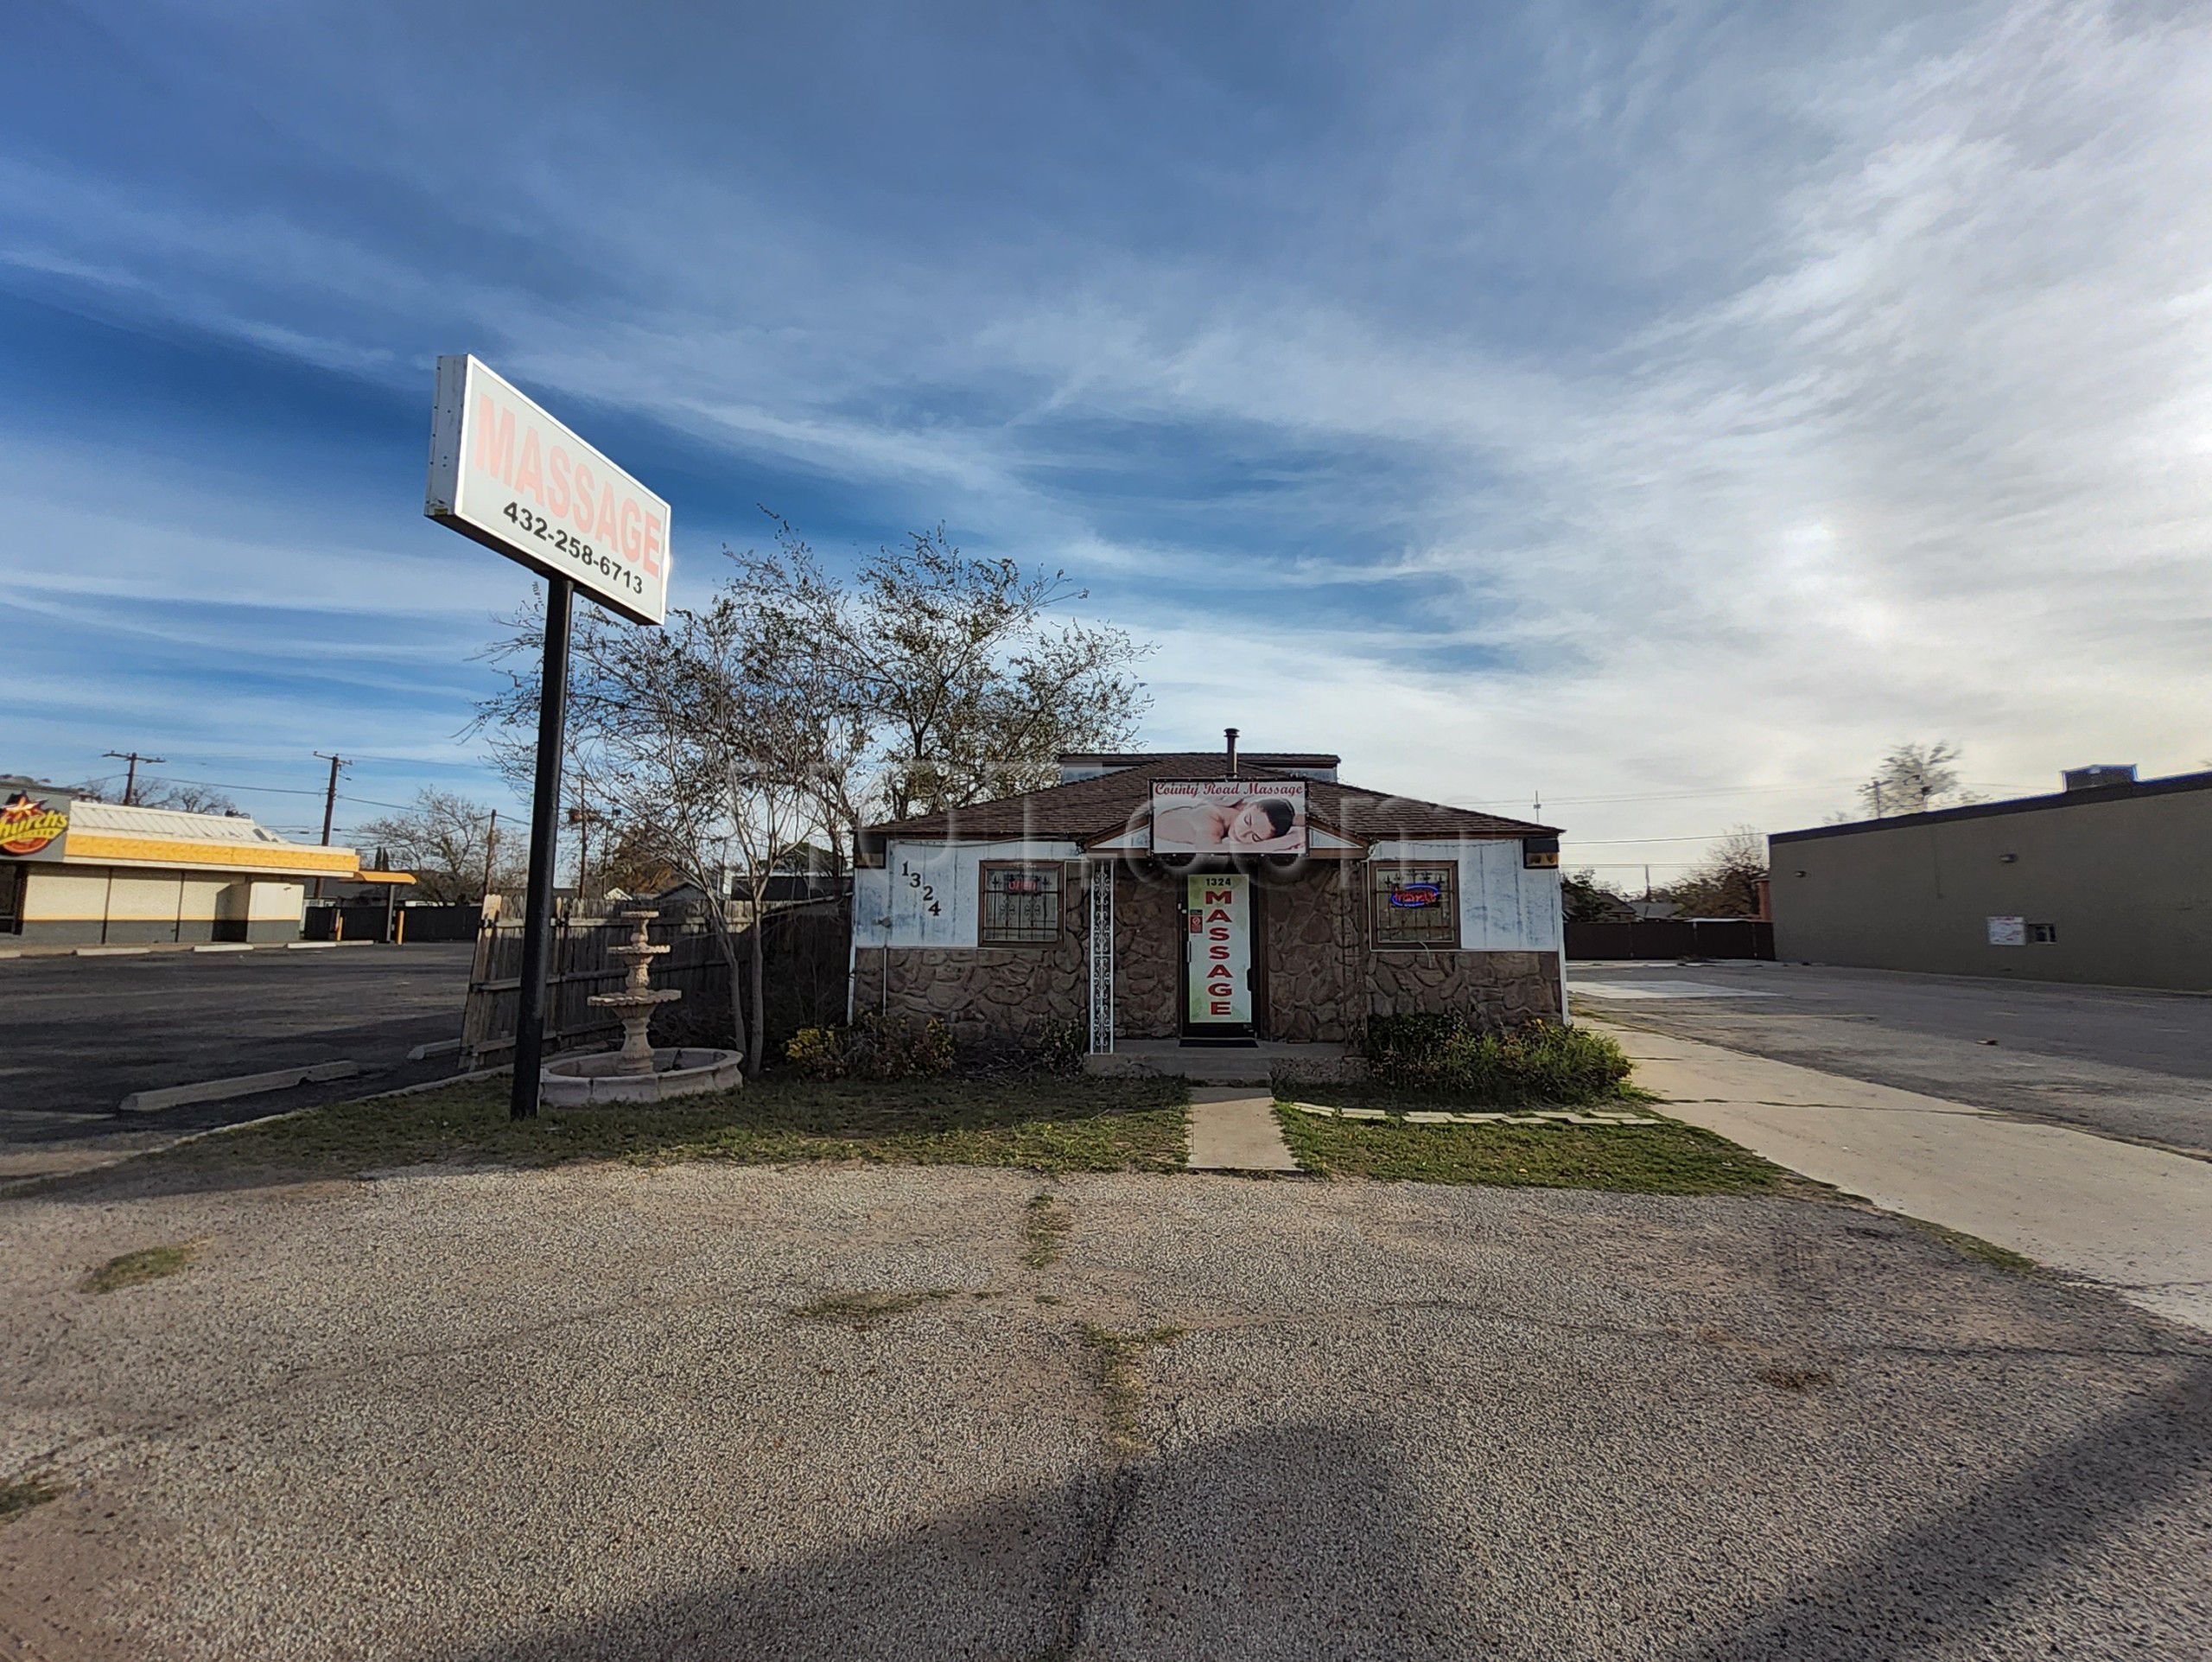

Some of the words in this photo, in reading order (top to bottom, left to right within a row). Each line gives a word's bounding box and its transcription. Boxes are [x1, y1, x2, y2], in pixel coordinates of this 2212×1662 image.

[476, 393, 663, 578] MASSAGE
[503, 502, 643, 594] 432-258-6713
[1155, 782, 1199, 797] County
[1203, 782, 1240, 795] Road
[1243, 782, 1303, 797] Massage
[0, 809, 68, 838] hurch's
[901, 860, 942, 917] 1324
[1206, 877, 1231, 887] 1324
[1205, 890, 1233, 1016] MASSAGE
